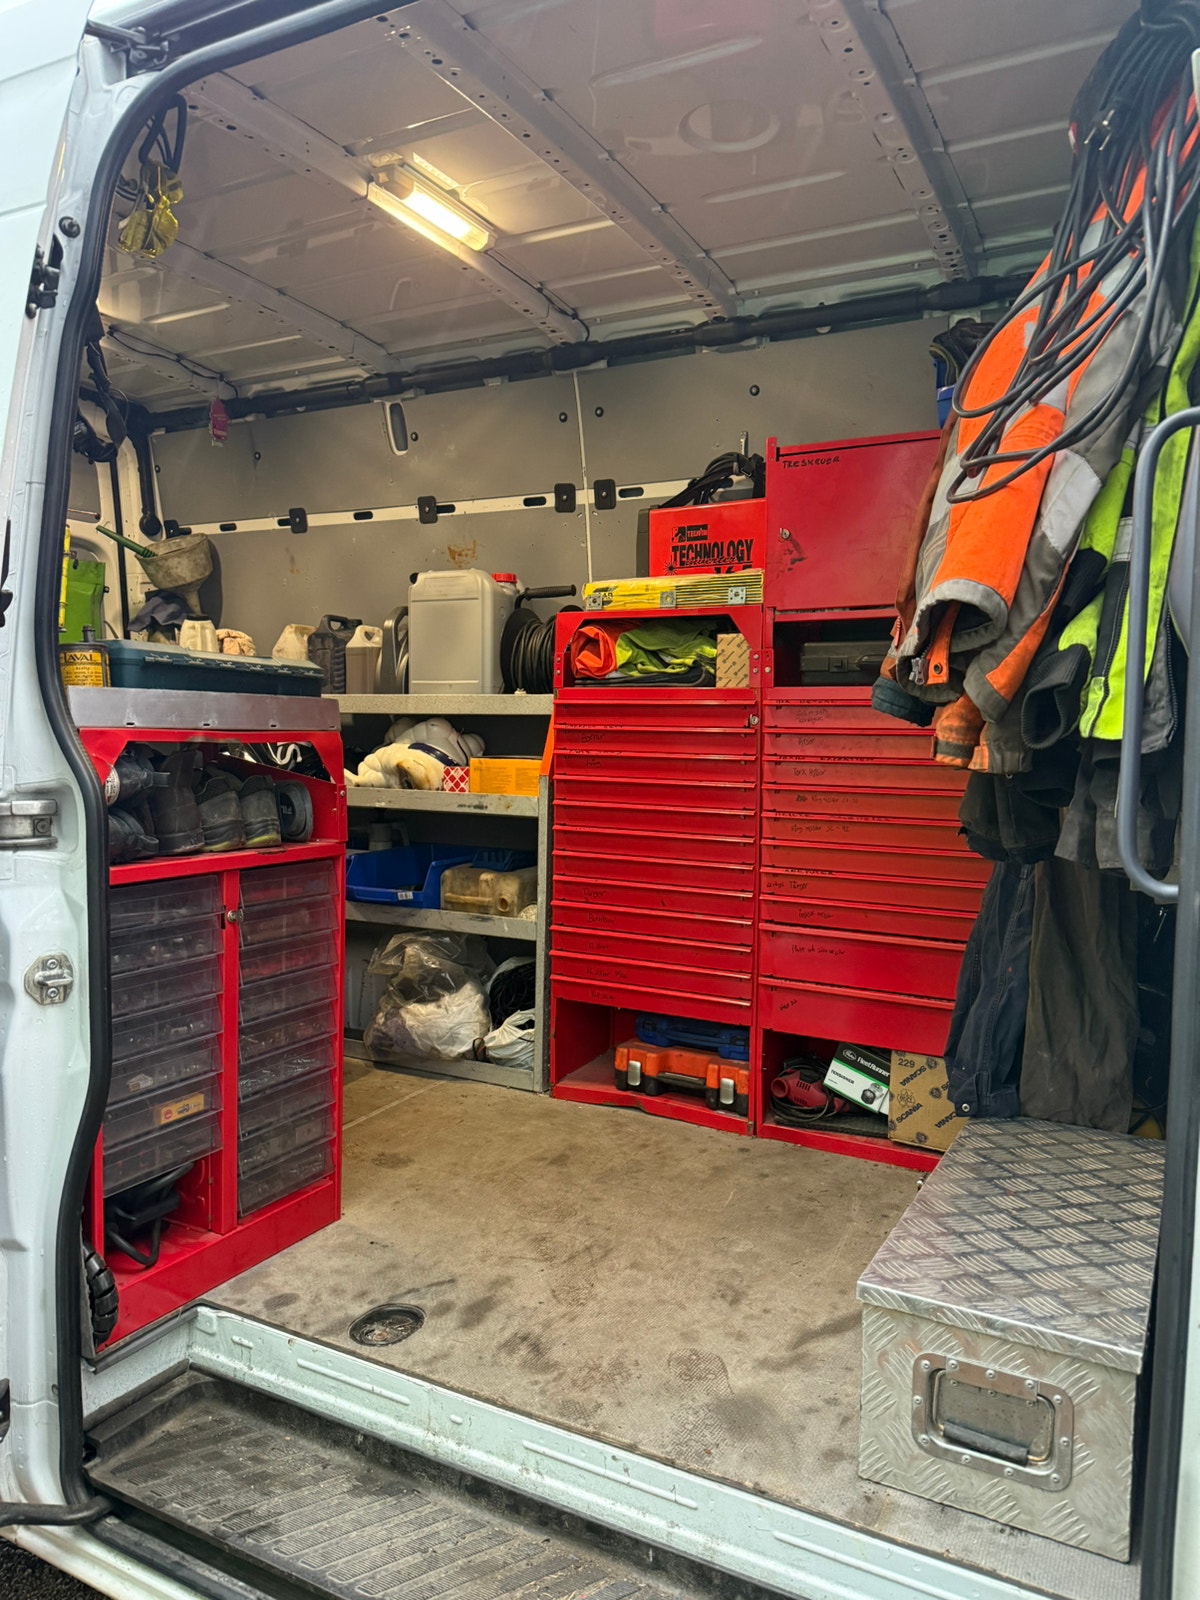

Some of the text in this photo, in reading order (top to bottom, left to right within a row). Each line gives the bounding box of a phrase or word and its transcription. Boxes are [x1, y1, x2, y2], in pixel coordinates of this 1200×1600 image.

[672, 540, 753, 566] TECHNOLOGY
[856, 1056, 890, 1078] FleetRunner
[898, 1058, 915, 1068] 229
[830, 1069, 855, 1085] TENSIONER
[900, 1065, 927, 1087] SCANIA
[896, 1102, 923, 1124] SCANIA
